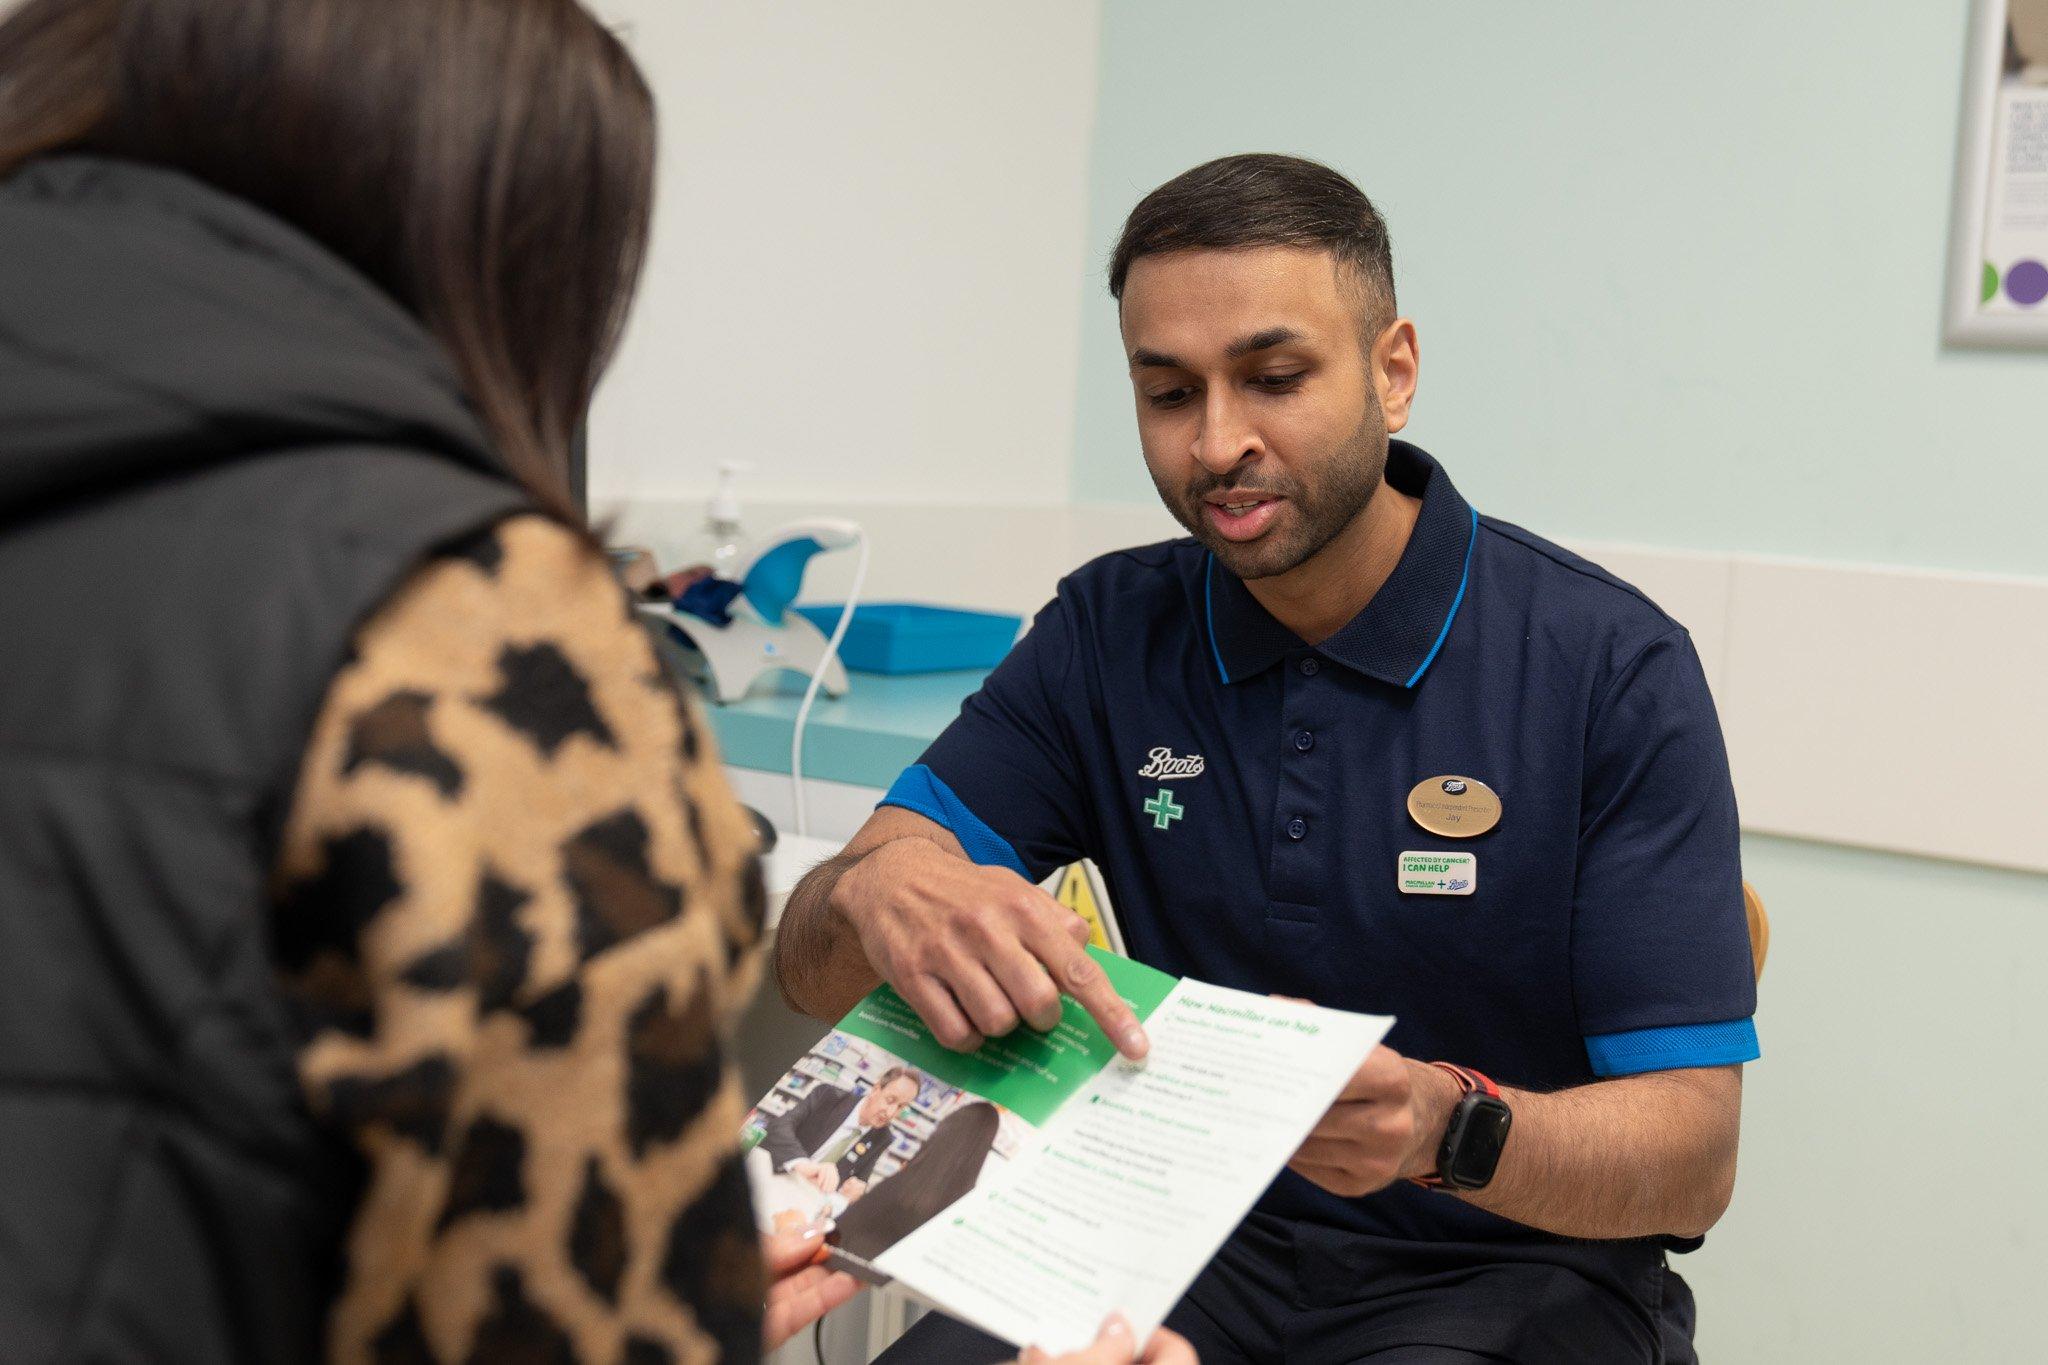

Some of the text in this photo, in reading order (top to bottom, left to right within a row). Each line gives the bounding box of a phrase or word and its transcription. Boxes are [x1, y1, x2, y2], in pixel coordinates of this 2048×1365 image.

[1138, 747, 1205, 781] Boots
[1446, 814, 1461, 822] Jay
[1407, 864, 1427, 872] CAN
[1428, 865, 1450, 873] HELP
[1178, 996, 1203, 1010] How
[1268, 1015, 1290, 1028] can
[1293, 1018, 1321, 1036] help
